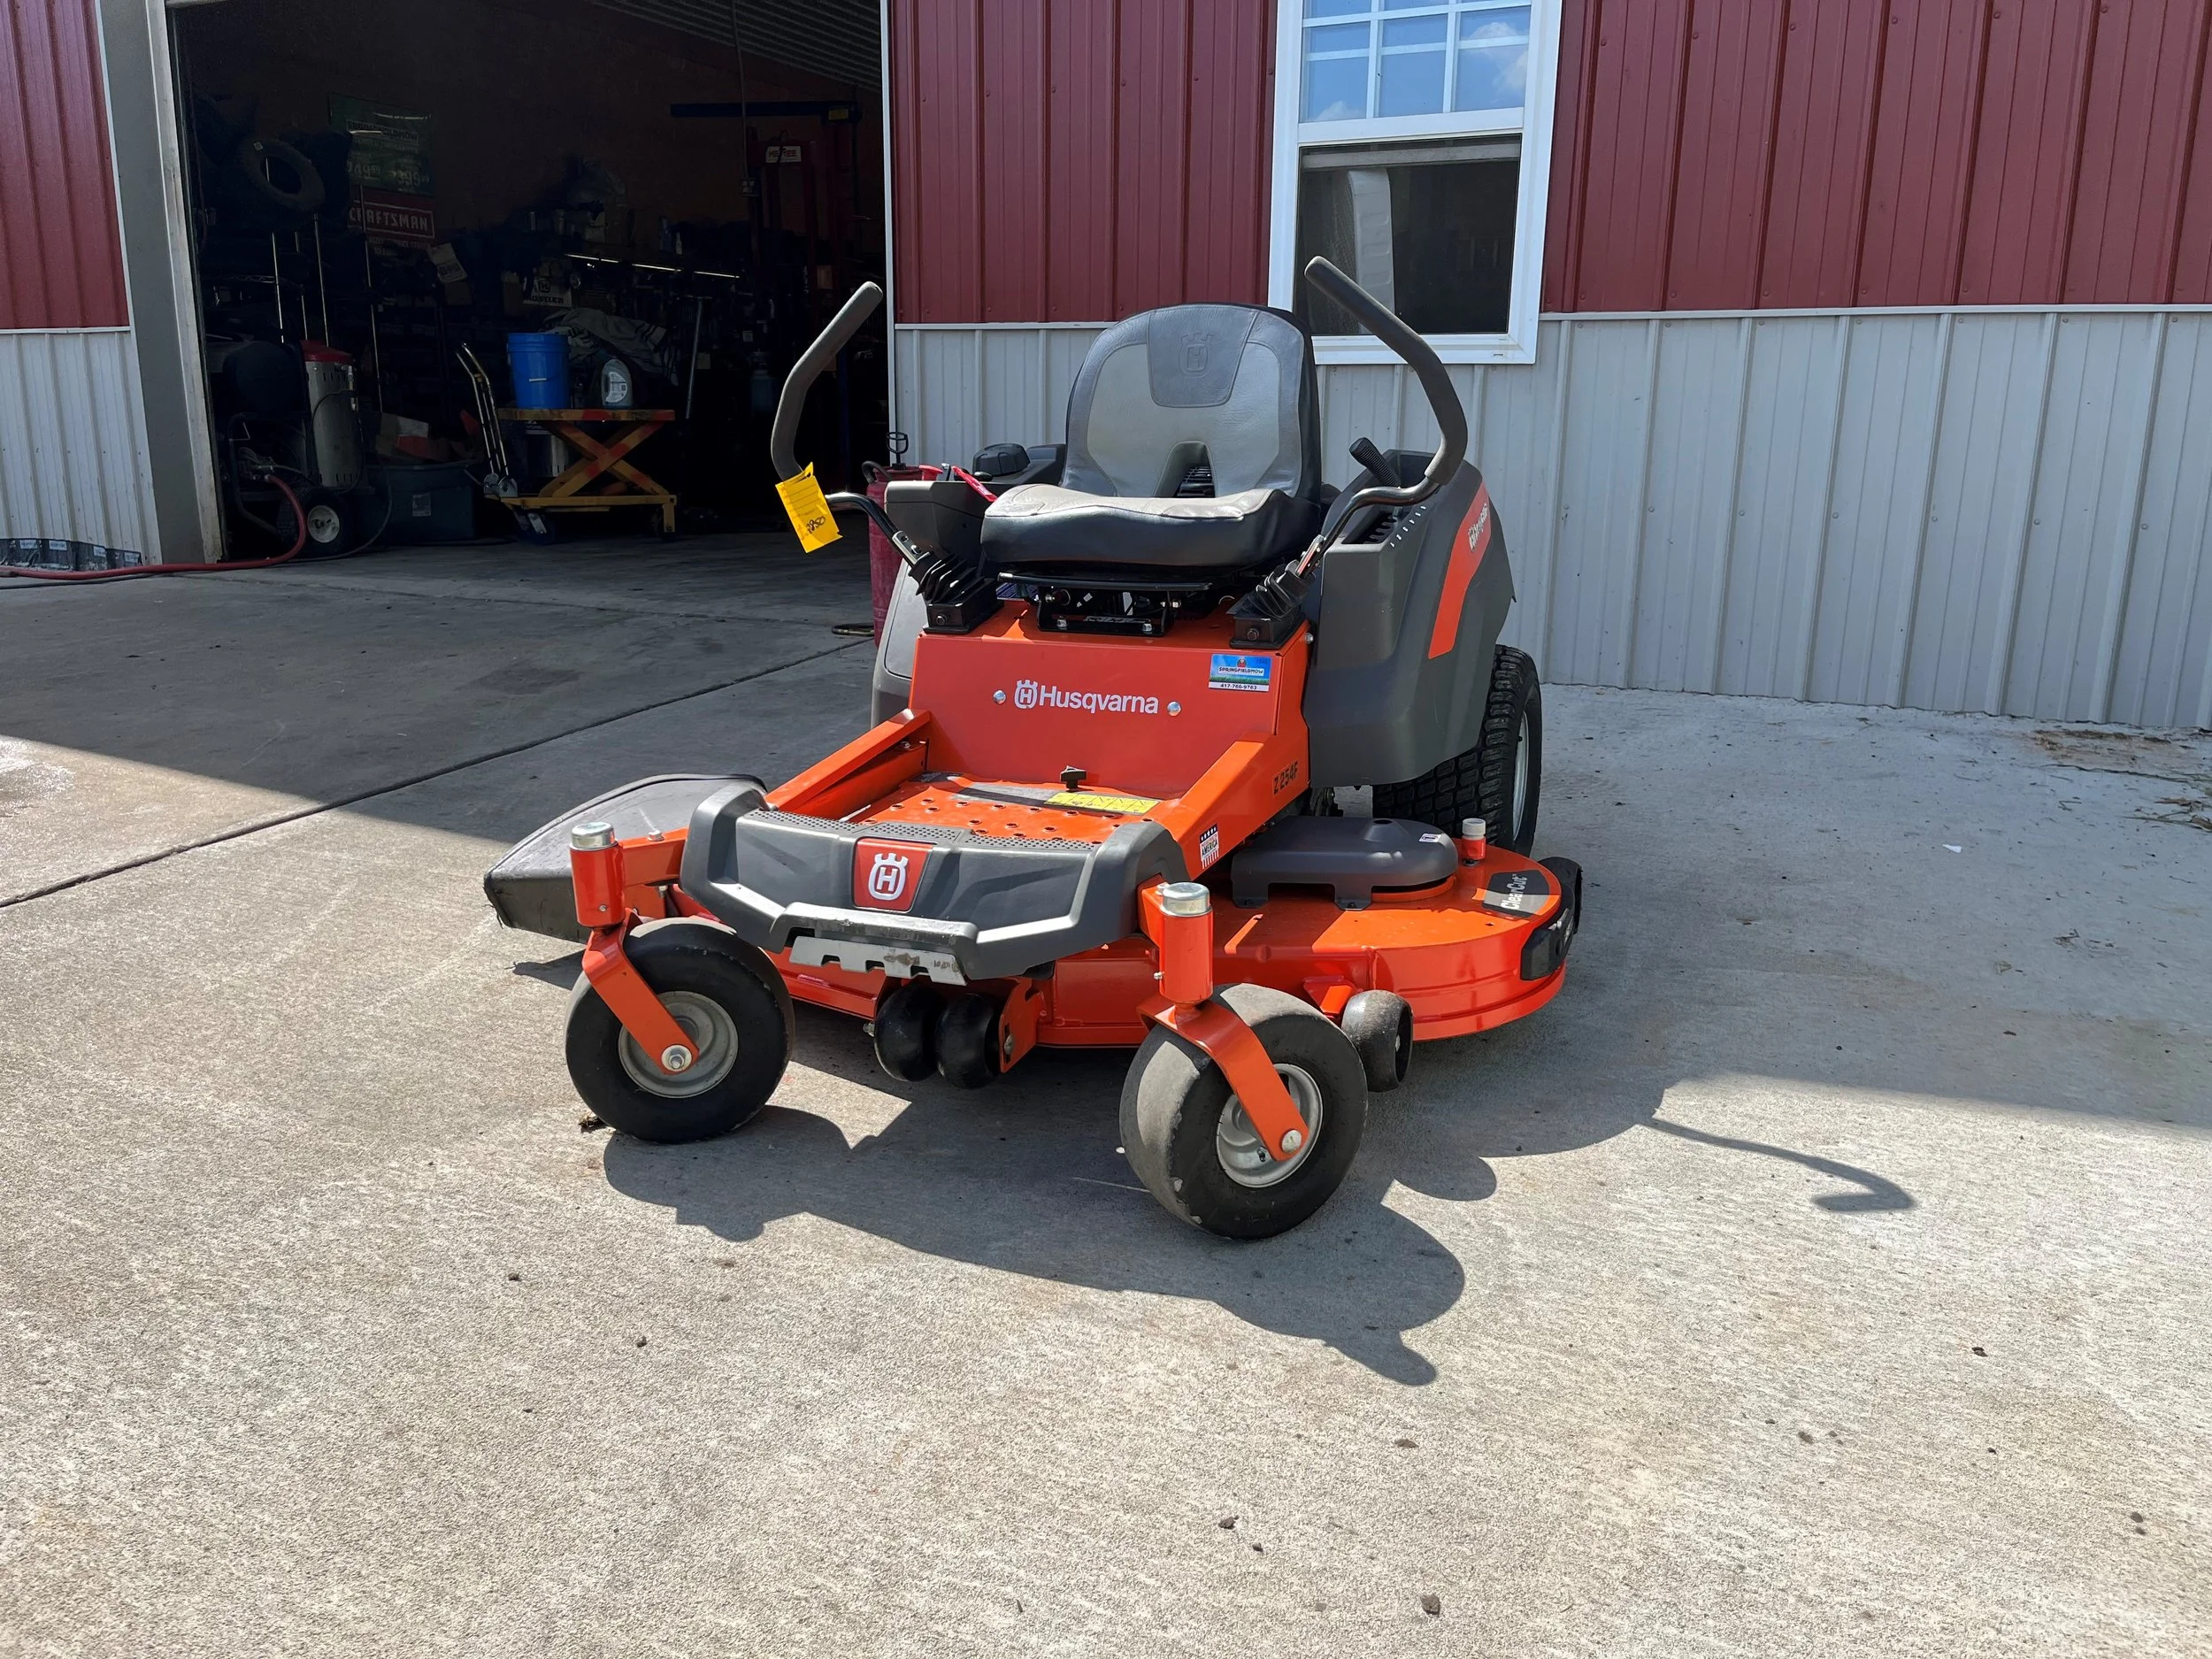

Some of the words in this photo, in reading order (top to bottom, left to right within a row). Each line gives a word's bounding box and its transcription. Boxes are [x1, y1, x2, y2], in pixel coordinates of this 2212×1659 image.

[1039, 685, 1159, 714] Husqvarna
[1274, 776, 1279, 795] Z
[1279, 761, 1298, 789] 254F
